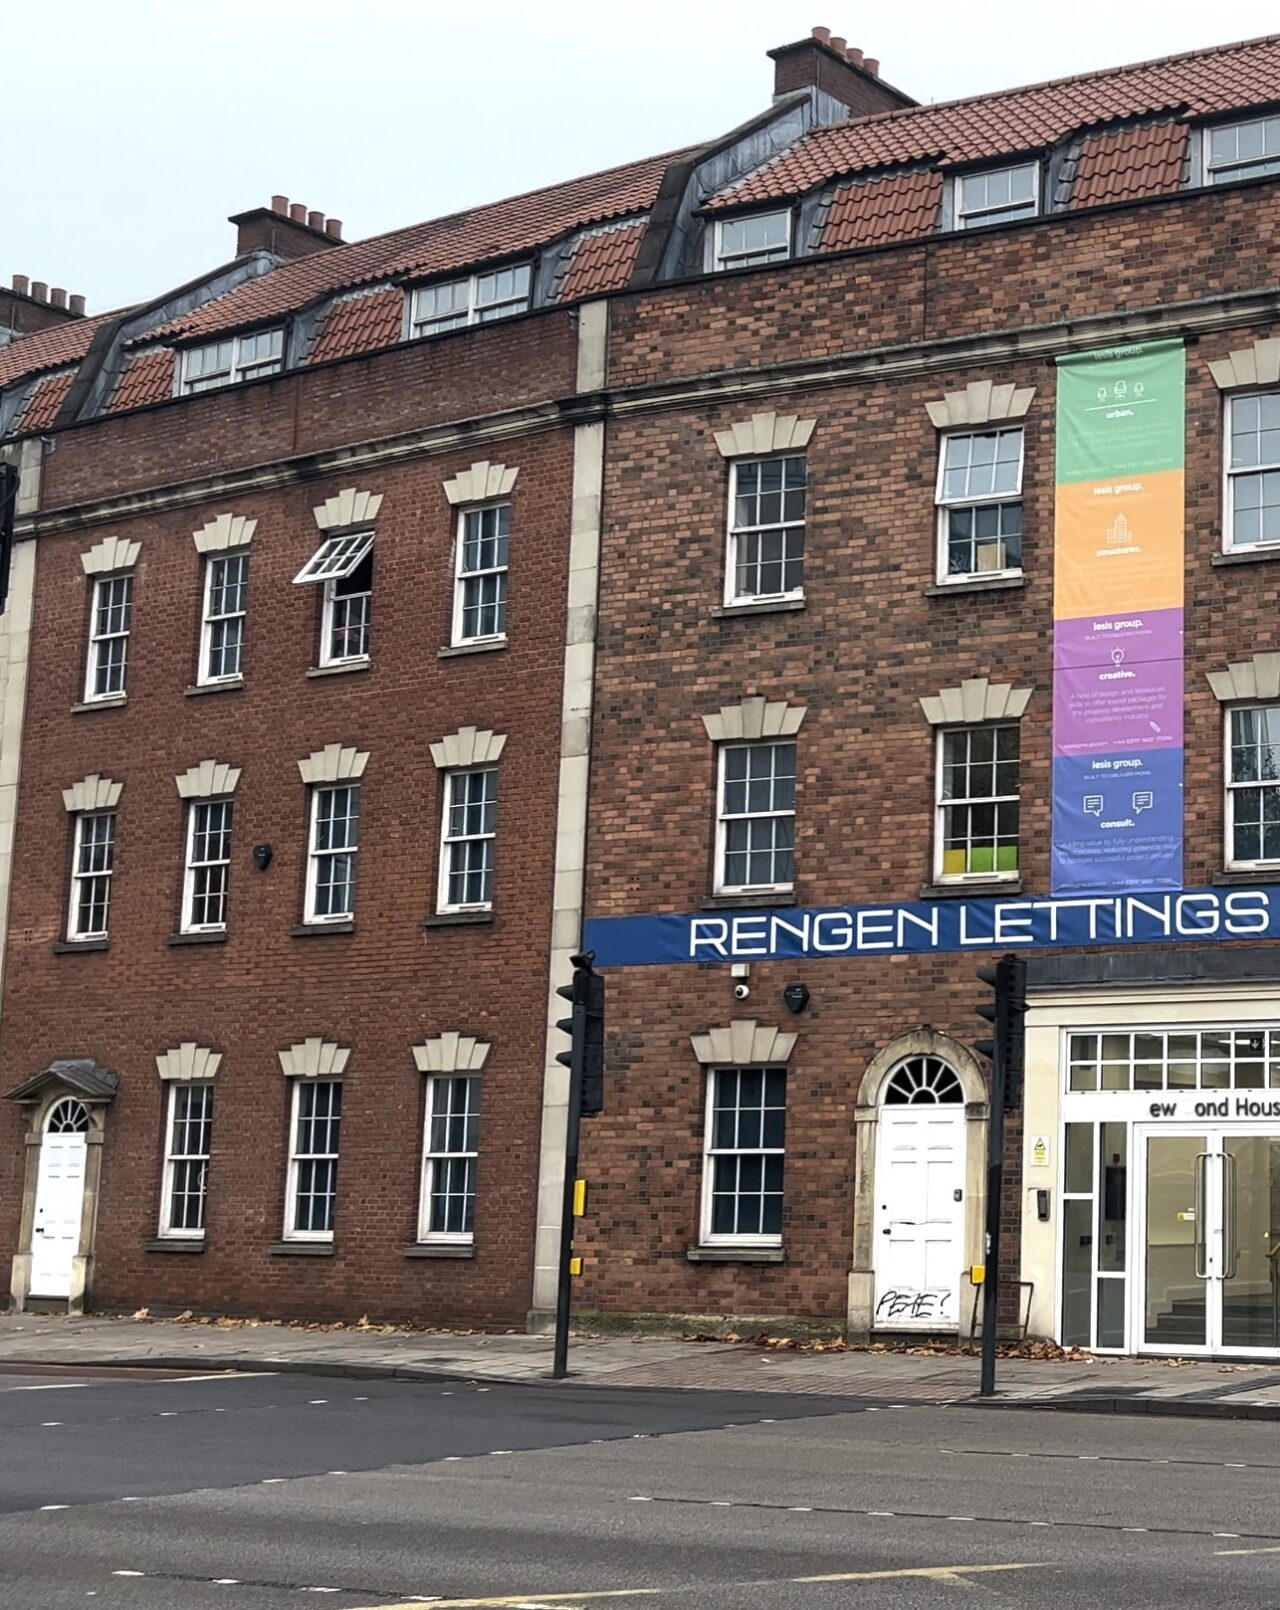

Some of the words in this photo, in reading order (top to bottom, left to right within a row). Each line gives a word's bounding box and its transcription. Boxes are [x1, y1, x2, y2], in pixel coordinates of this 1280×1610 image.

[1114, 619, 1144, 630] group.
[1099, 670, 1136, 681] creative.
[1113, 758, 1143, 770] group.
[1100, 818, 1135, 829] consult.
[690, 907, 938, 956] RENGEN
[960, 891, 1269, 945] LETTINGS
